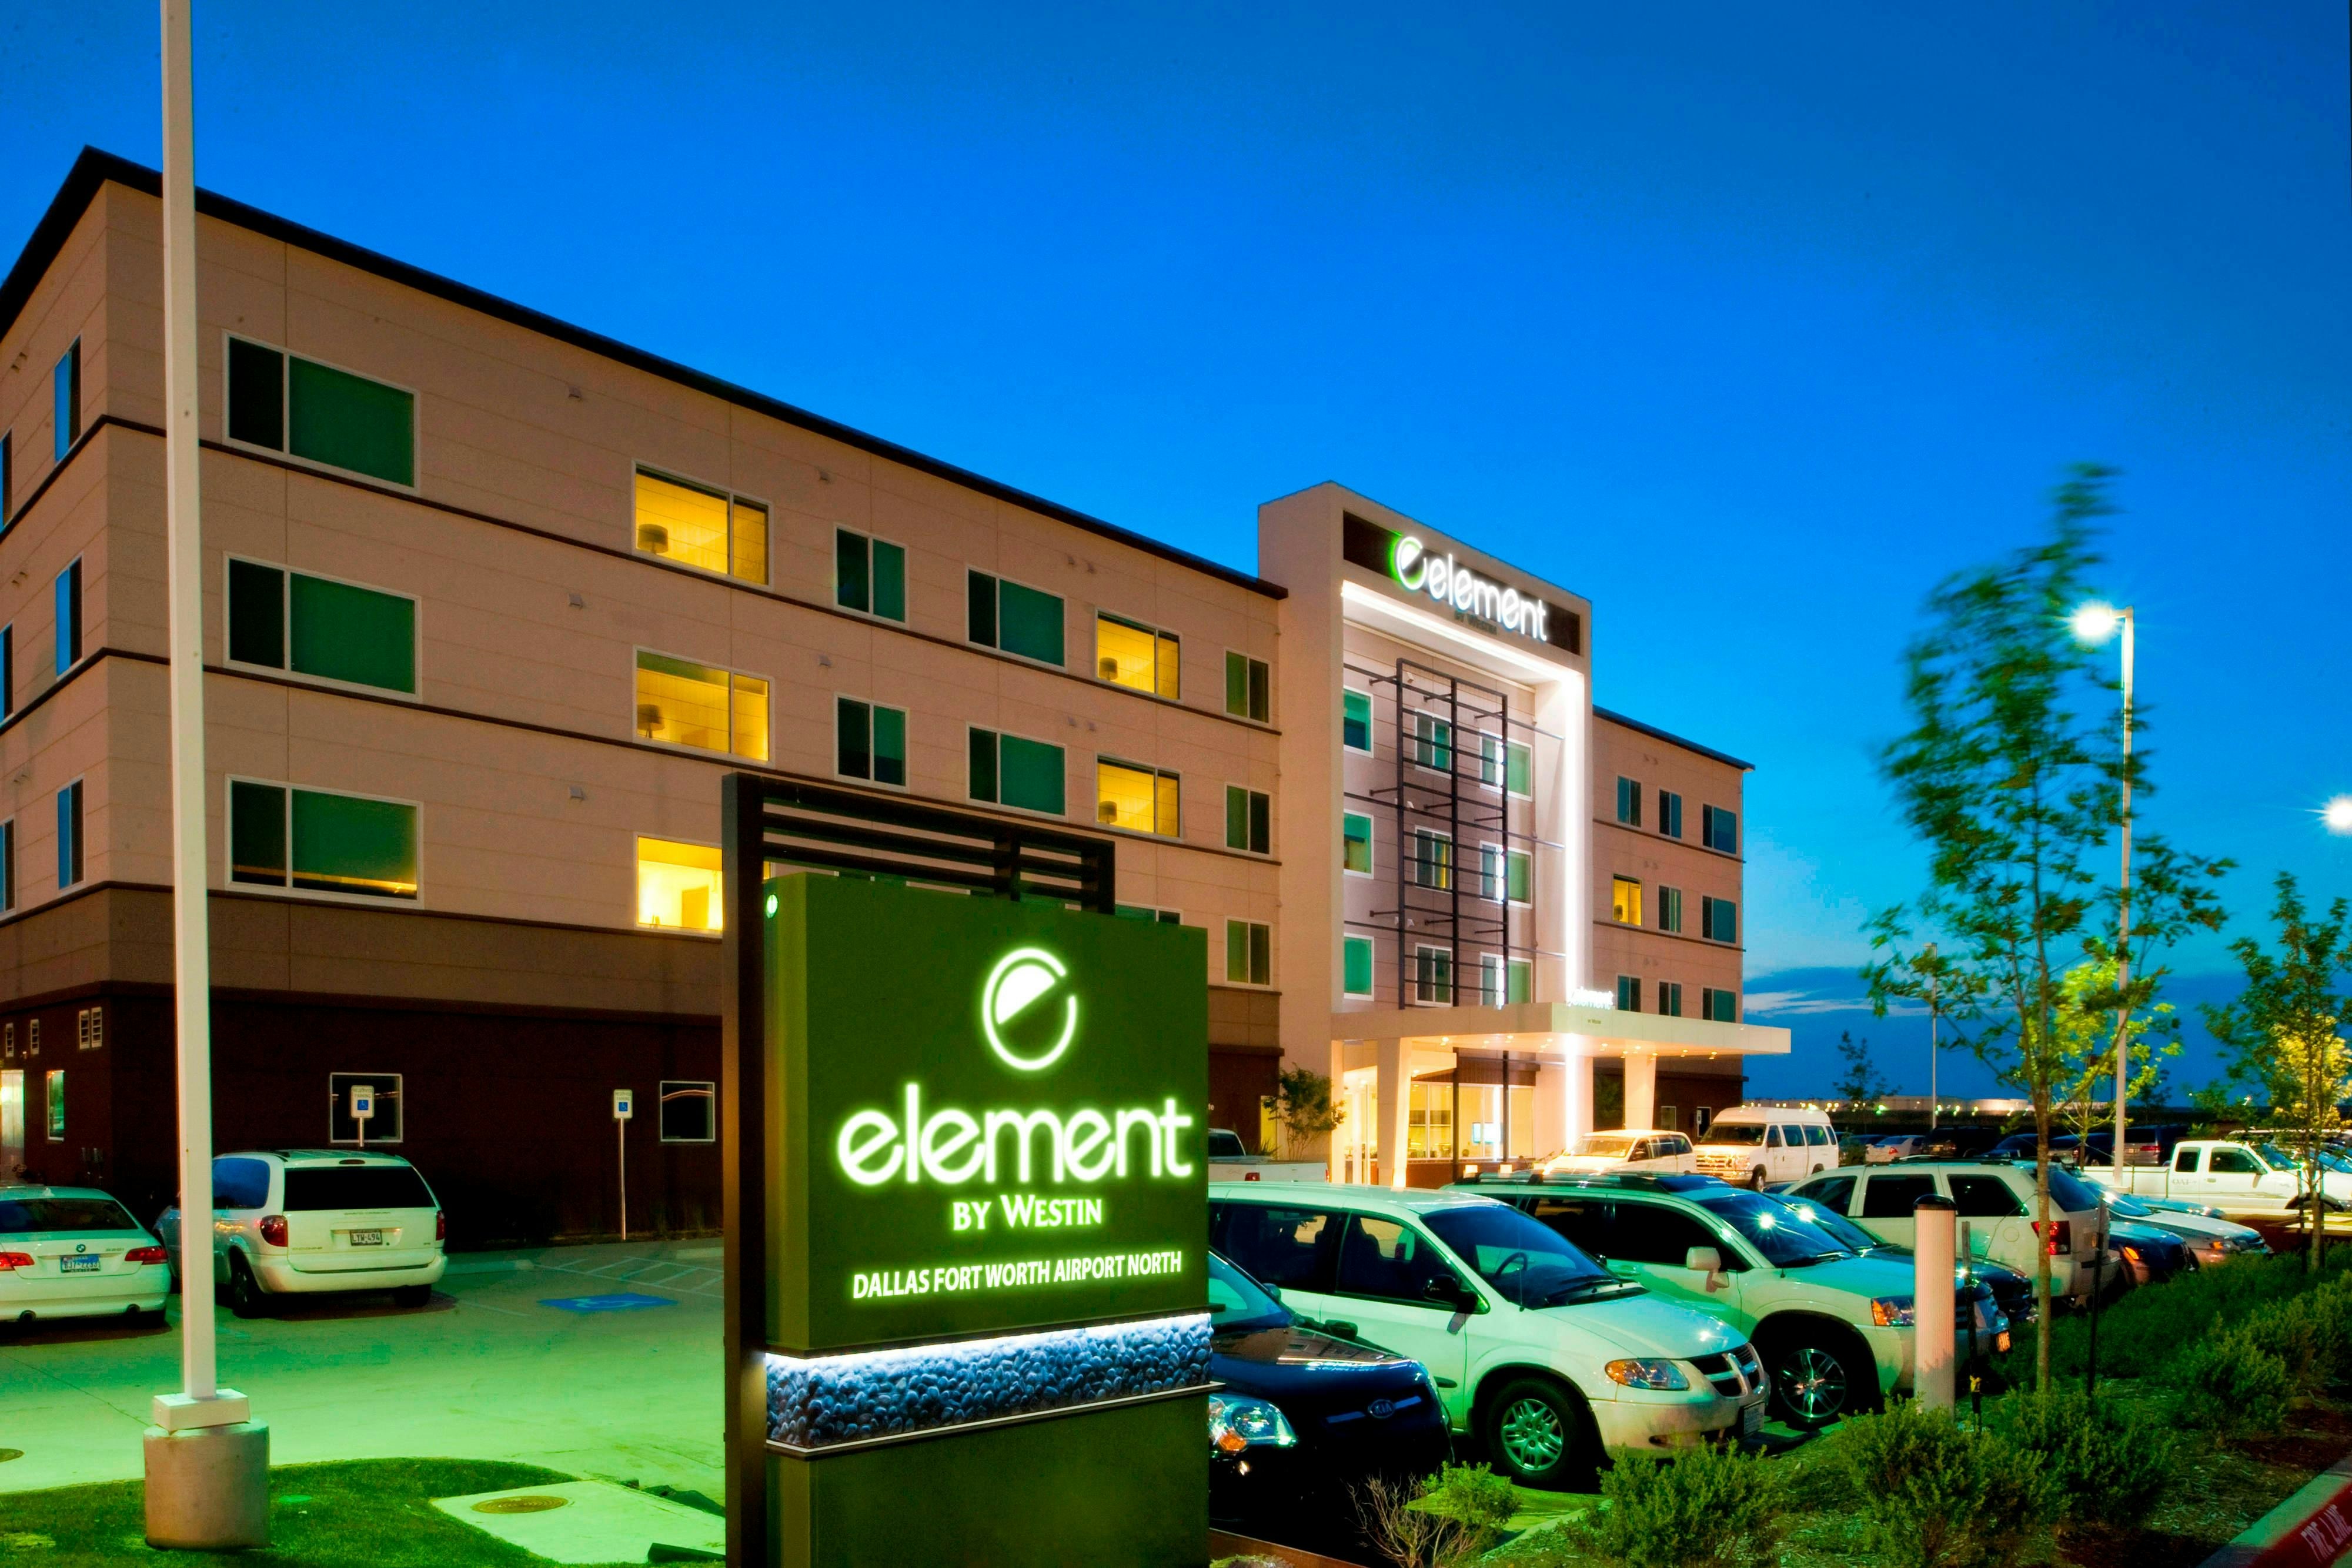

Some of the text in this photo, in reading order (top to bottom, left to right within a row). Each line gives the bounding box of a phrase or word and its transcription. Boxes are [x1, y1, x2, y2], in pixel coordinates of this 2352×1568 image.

[1428, 553, 1546, 641] element
[838, 1083, 1192, 1185] element
[953, 1201, 991, 1230] BY
[853, 1251, 1181, 1299] DALLAS FORT WORTH AIRPORT NORTH
